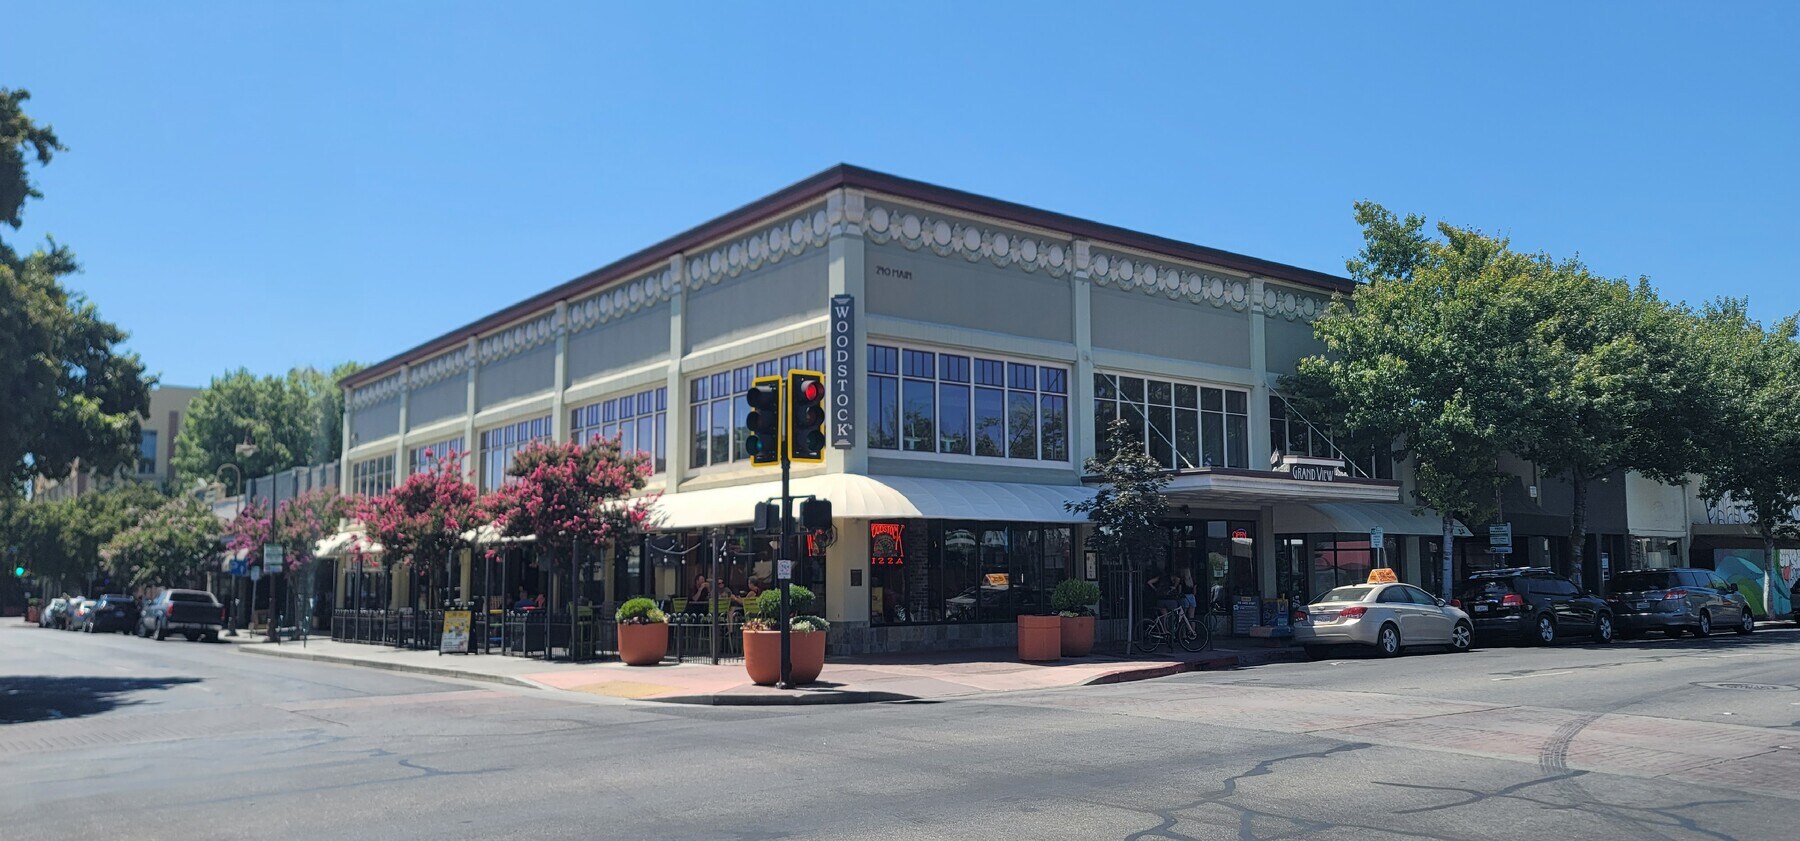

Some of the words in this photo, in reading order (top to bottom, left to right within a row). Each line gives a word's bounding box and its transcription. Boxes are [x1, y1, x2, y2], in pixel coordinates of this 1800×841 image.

[892, 268, 912, 281] MAIN
[1292, 465, 1315, 481] GRAND
[1316, 466, 1334, 482] VIEW
[871, 557, 904, 565] IZZA
